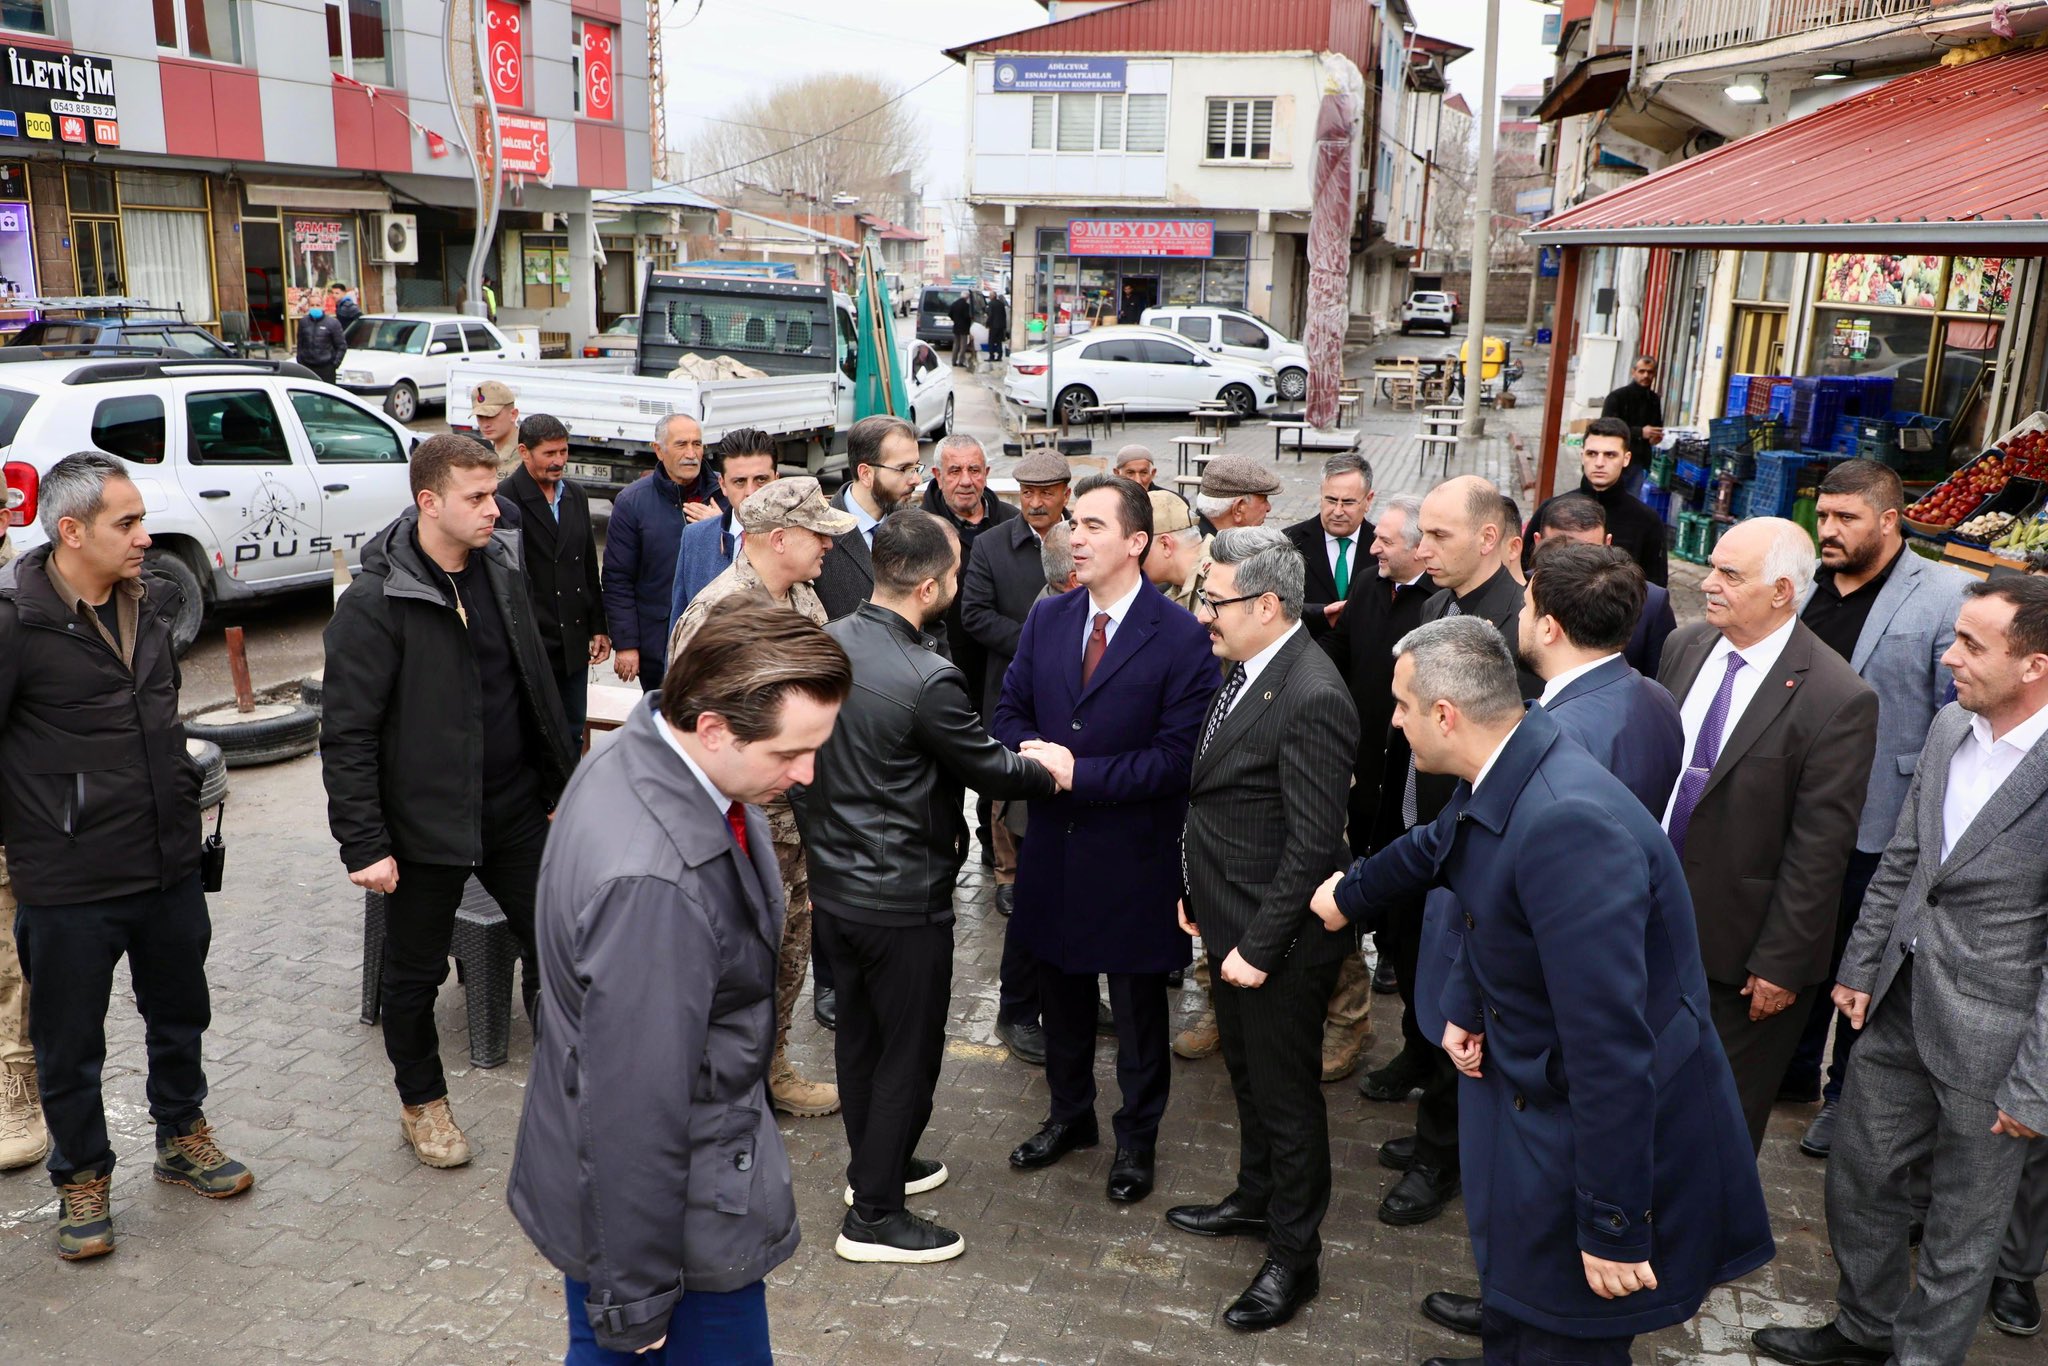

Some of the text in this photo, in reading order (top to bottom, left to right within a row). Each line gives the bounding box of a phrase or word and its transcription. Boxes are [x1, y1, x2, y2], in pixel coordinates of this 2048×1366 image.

[8, 47, 115, 101] İLETİŞİM
[1015, 80, 1038, 88] KREDİ
[54, 101, 114, 117] 0543 858 53 27
[27, 120, 51, 132] POCO
[1086, 222, 1197, 238] MEYDAN
[575, 465, 585, 475] AT
[592, 466, 608, 477] 395
[235, 531, 379, 563] DUST
